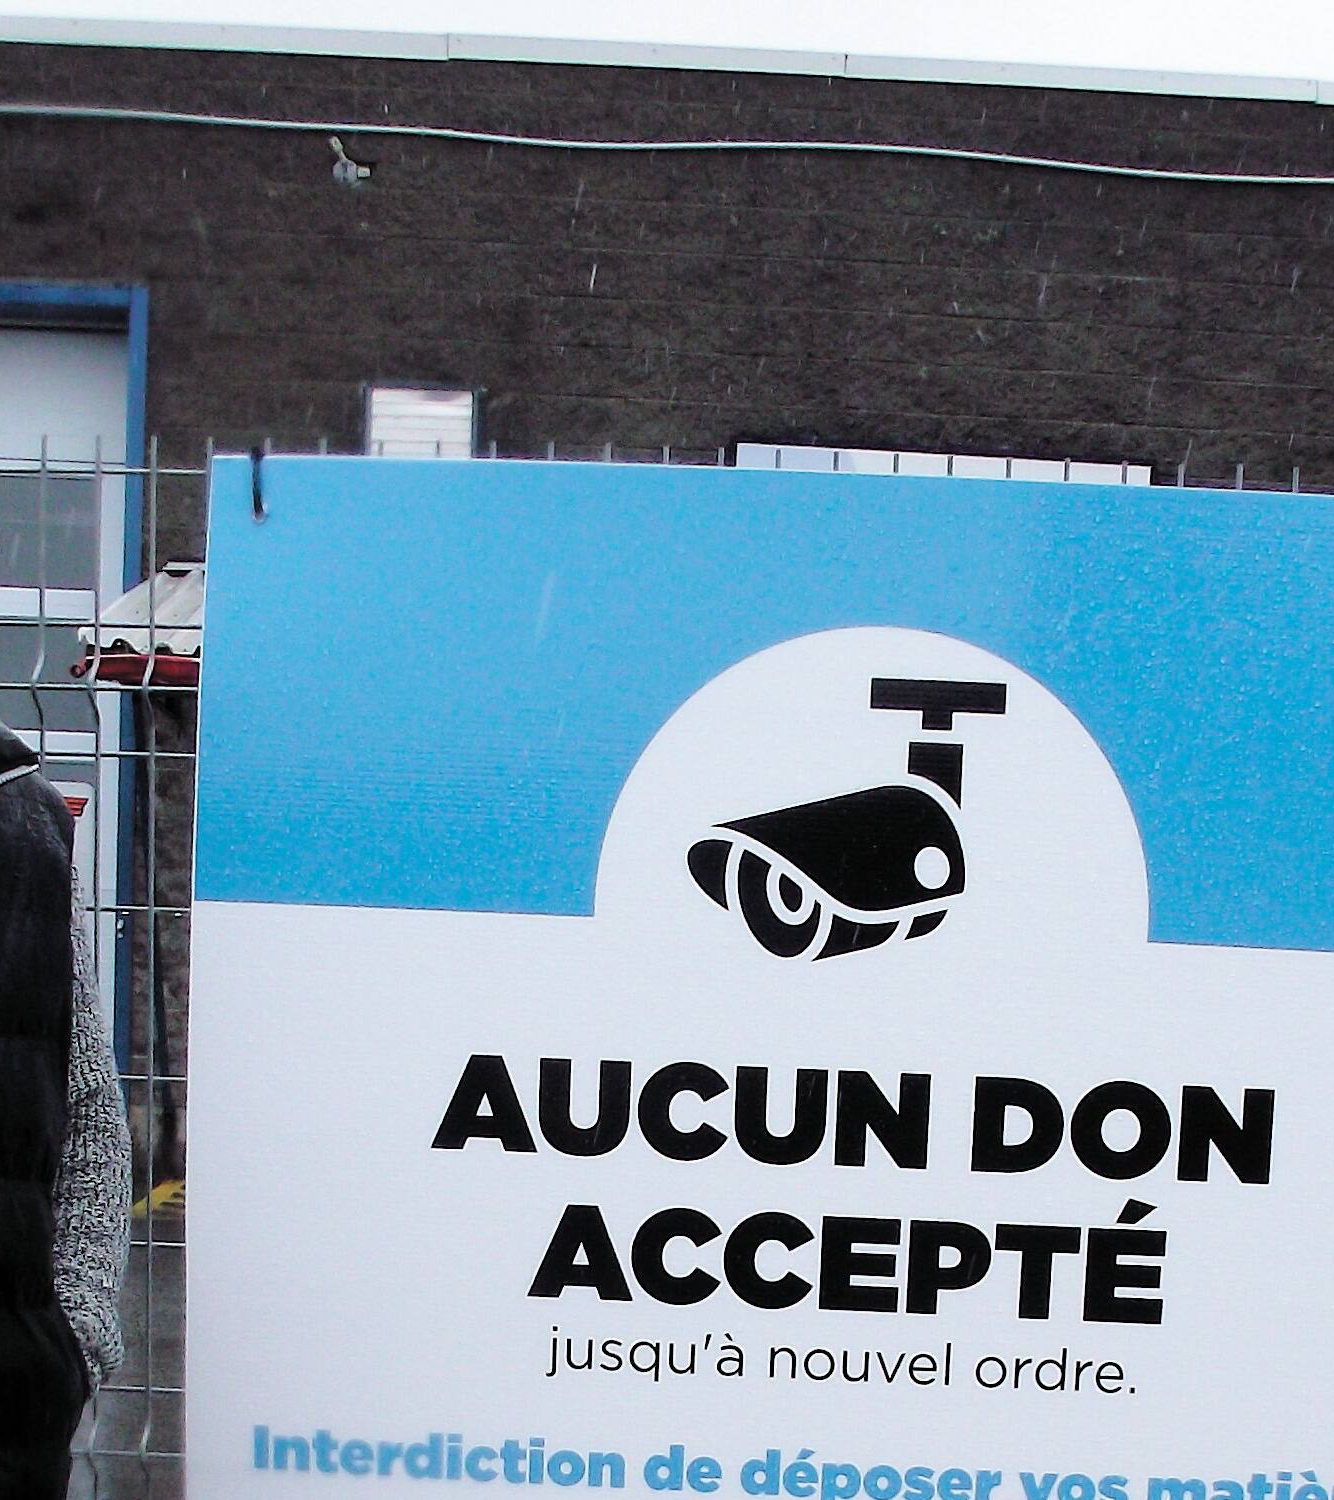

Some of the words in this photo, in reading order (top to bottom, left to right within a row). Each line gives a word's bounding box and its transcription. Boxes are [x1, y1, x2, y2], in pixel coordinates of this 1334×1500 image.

[431, 1055, 931, 1169] AUCUN
[971, 1077, 1275, 1184] DON
[527, 1199, 1167, 1324] ACCEPTÉ
[546, 1326, 743, 1381] jusqu'à
[770, 1343, 951, 1385] nouvel
[976, 1348, 1137, 1395] ordre.
[253, 1425, 625, 1488] Interdiction
[644, 1445, 722, 1493] de
